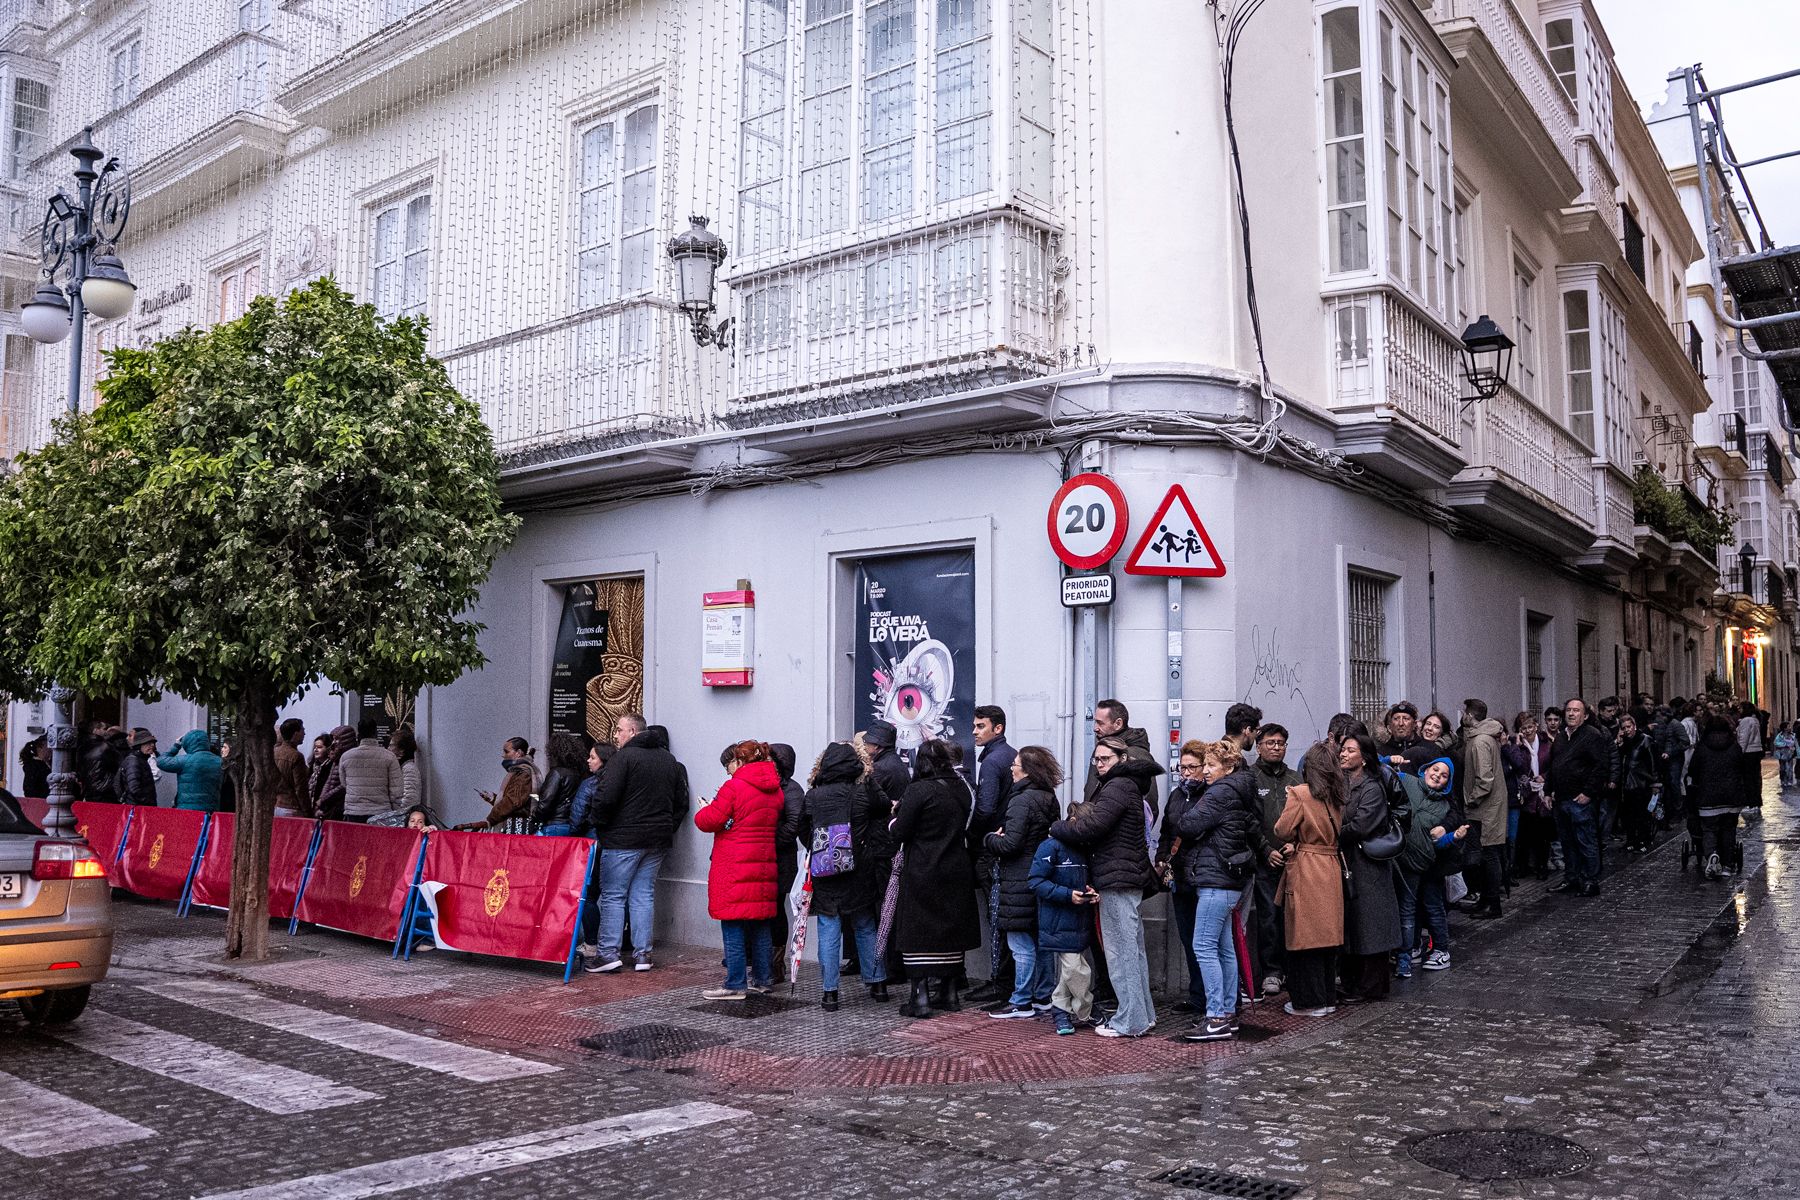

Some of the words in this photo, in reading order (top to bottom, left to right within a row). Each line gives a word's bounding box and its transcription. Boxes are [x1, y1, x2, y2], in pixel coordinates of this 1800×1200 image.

[1065, 503, 1105, 534] 20
[871, 581, 879, 589] 20
[1066, 579, 1109, 590] PRIORIDAD
[1065, 590, 1110, 601] PEATONAL
[870, 618, 879, 627] EL
[880, 617, 900, 628] QUE
[900, 615, 922, 626] VIVA
[595, 625, 604, 633] de
[869, 627, 888, 642] LO
[888, 620, 931, 641] VERÁ
[573, 639, 603, 647] Cuaresma
